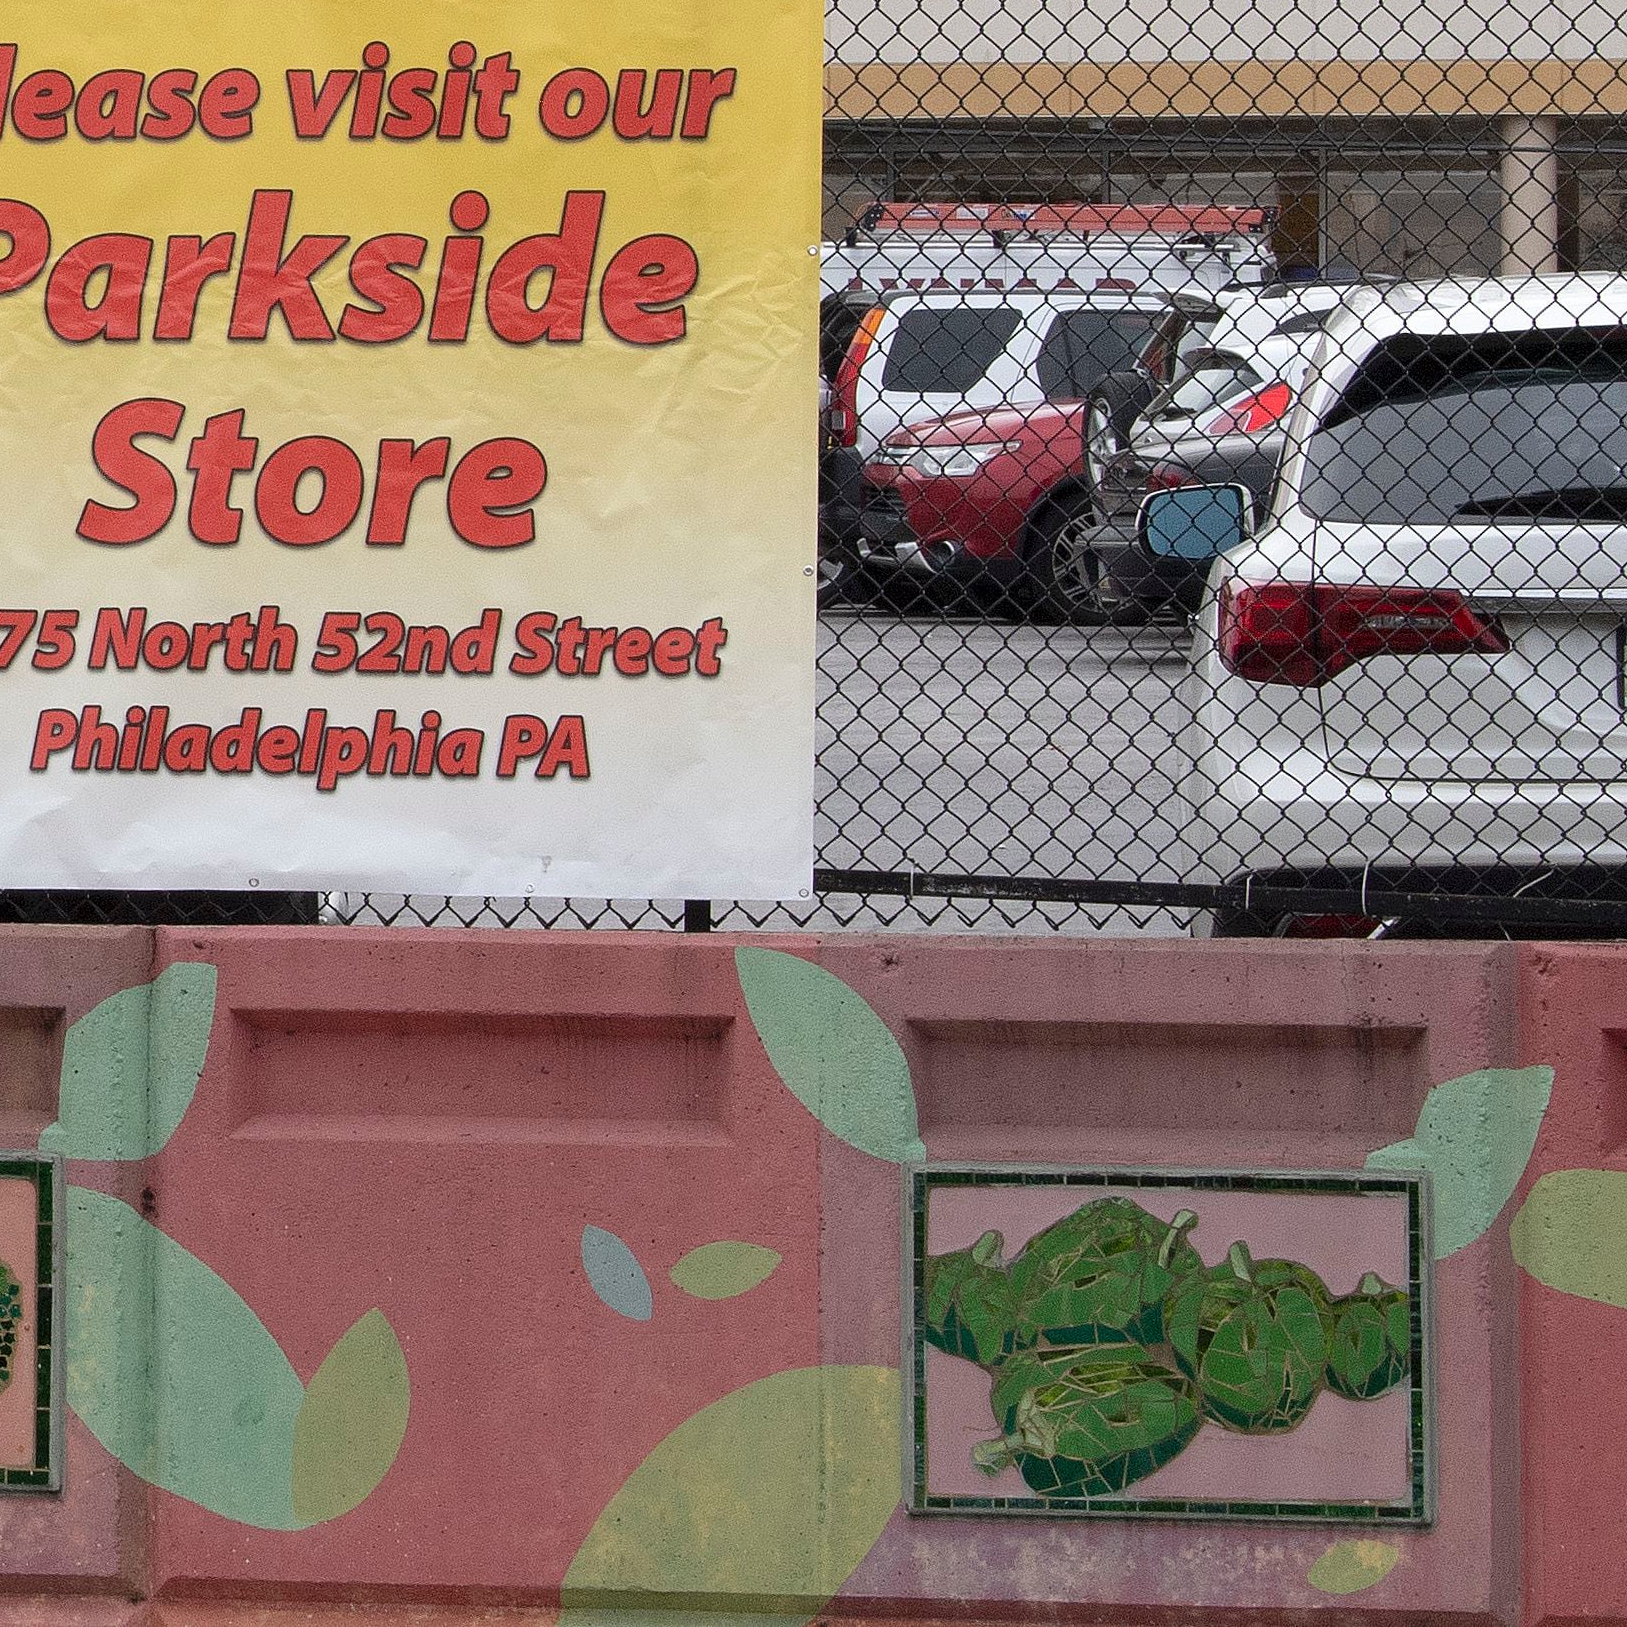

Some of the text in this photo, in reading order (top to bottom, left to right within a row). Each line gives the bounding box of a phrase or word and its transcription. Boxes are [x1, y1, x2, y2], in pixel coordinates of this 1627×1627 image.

[286, 41, 520, 142] visit
[539, 66, 738, 142] our
[75, 398, 547, 548] Store
[88, 606, 300, 672] North
[310, 608, 502, 675] 52nd
[509, 611, 729, 677] Street
[29, 704, 592, 791] Philadelphia PA
